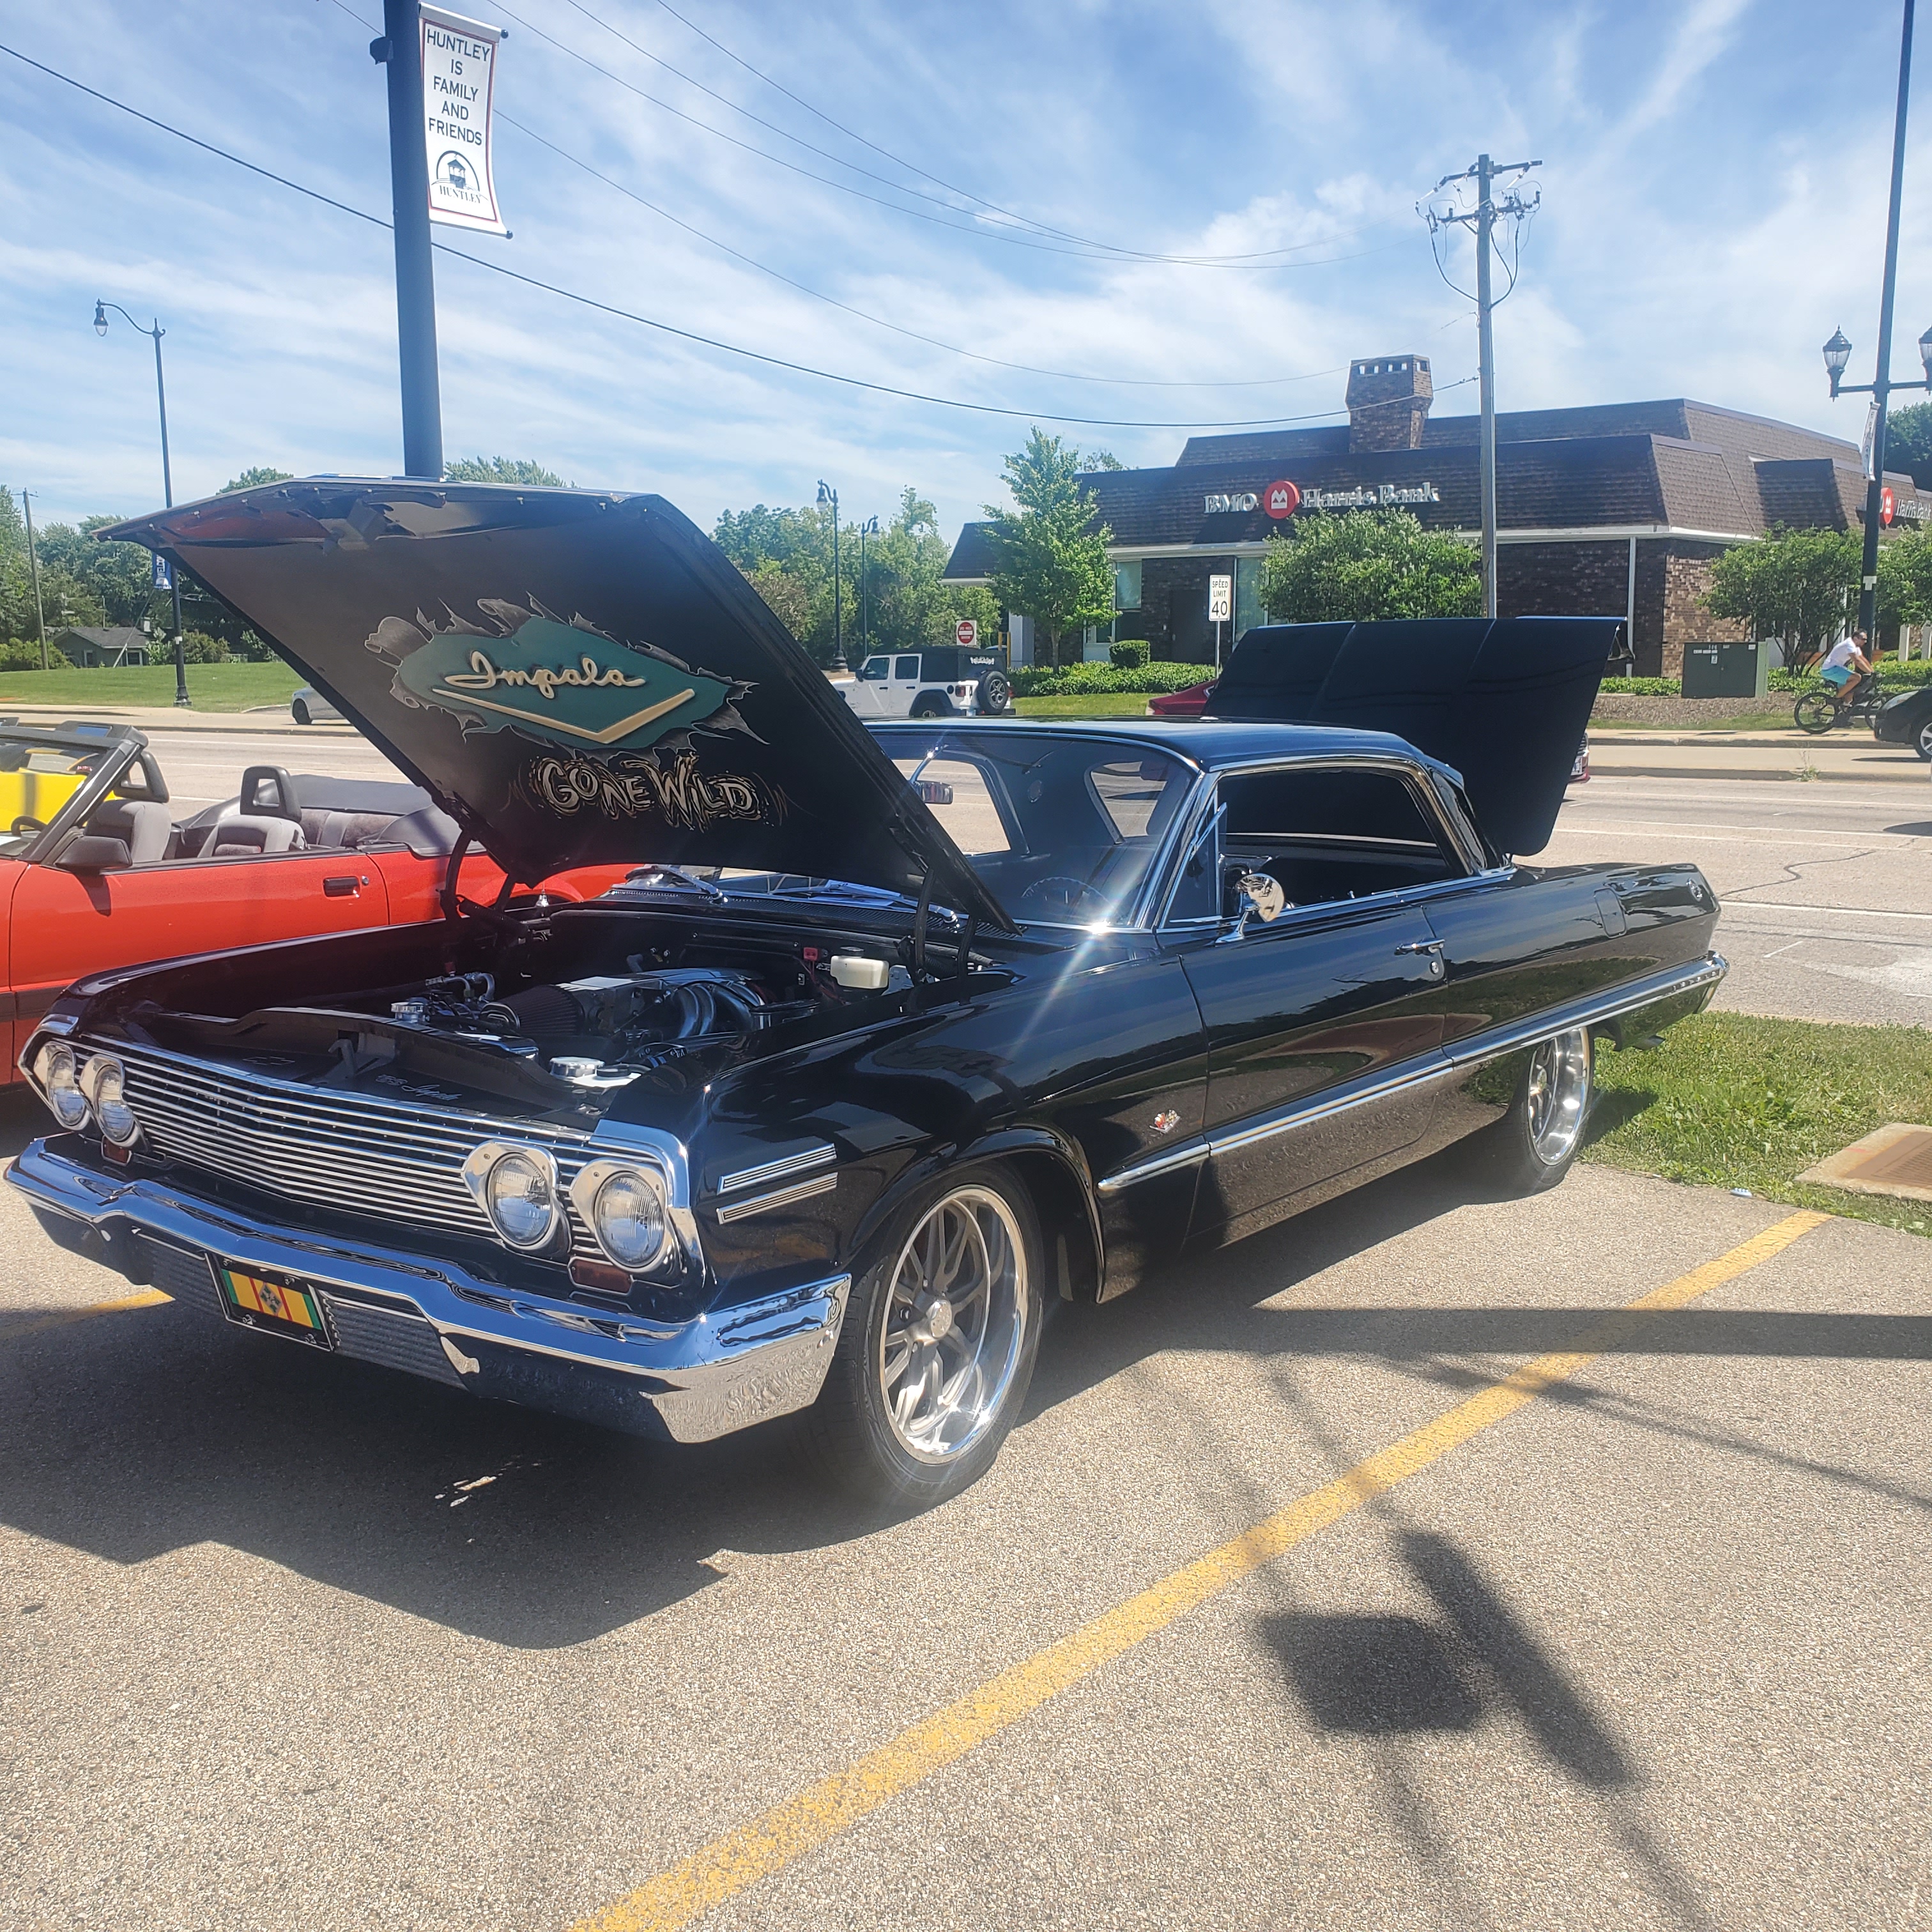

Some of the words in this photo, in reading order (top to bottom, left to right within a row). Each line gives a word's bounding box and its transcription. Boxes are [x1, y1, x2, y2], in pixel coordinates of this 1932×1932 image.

[427, 28, 490, 62] HUNTLEY
[450, 59, 463, 76] IS
[433, 75, 479, 102] FAMILY
[441, 100, 469, 121] AND
[429, 118, 482, 146] FRIENDS
[439, 185, 482, 204] HUNTLEY
[1204, 493, 1257, 514] BMO
[1301, 486, 1375, 509] Harris
[1377, 482, 1440, 504] Bank
[1896, 499, 1916, 518] Harris
[1916, 502, 1931, 520] Bank
[1211, 601, 1227, 616] 40
[444, 650, 645, 699] Impala
[539, 758, 654, 817] GONE
